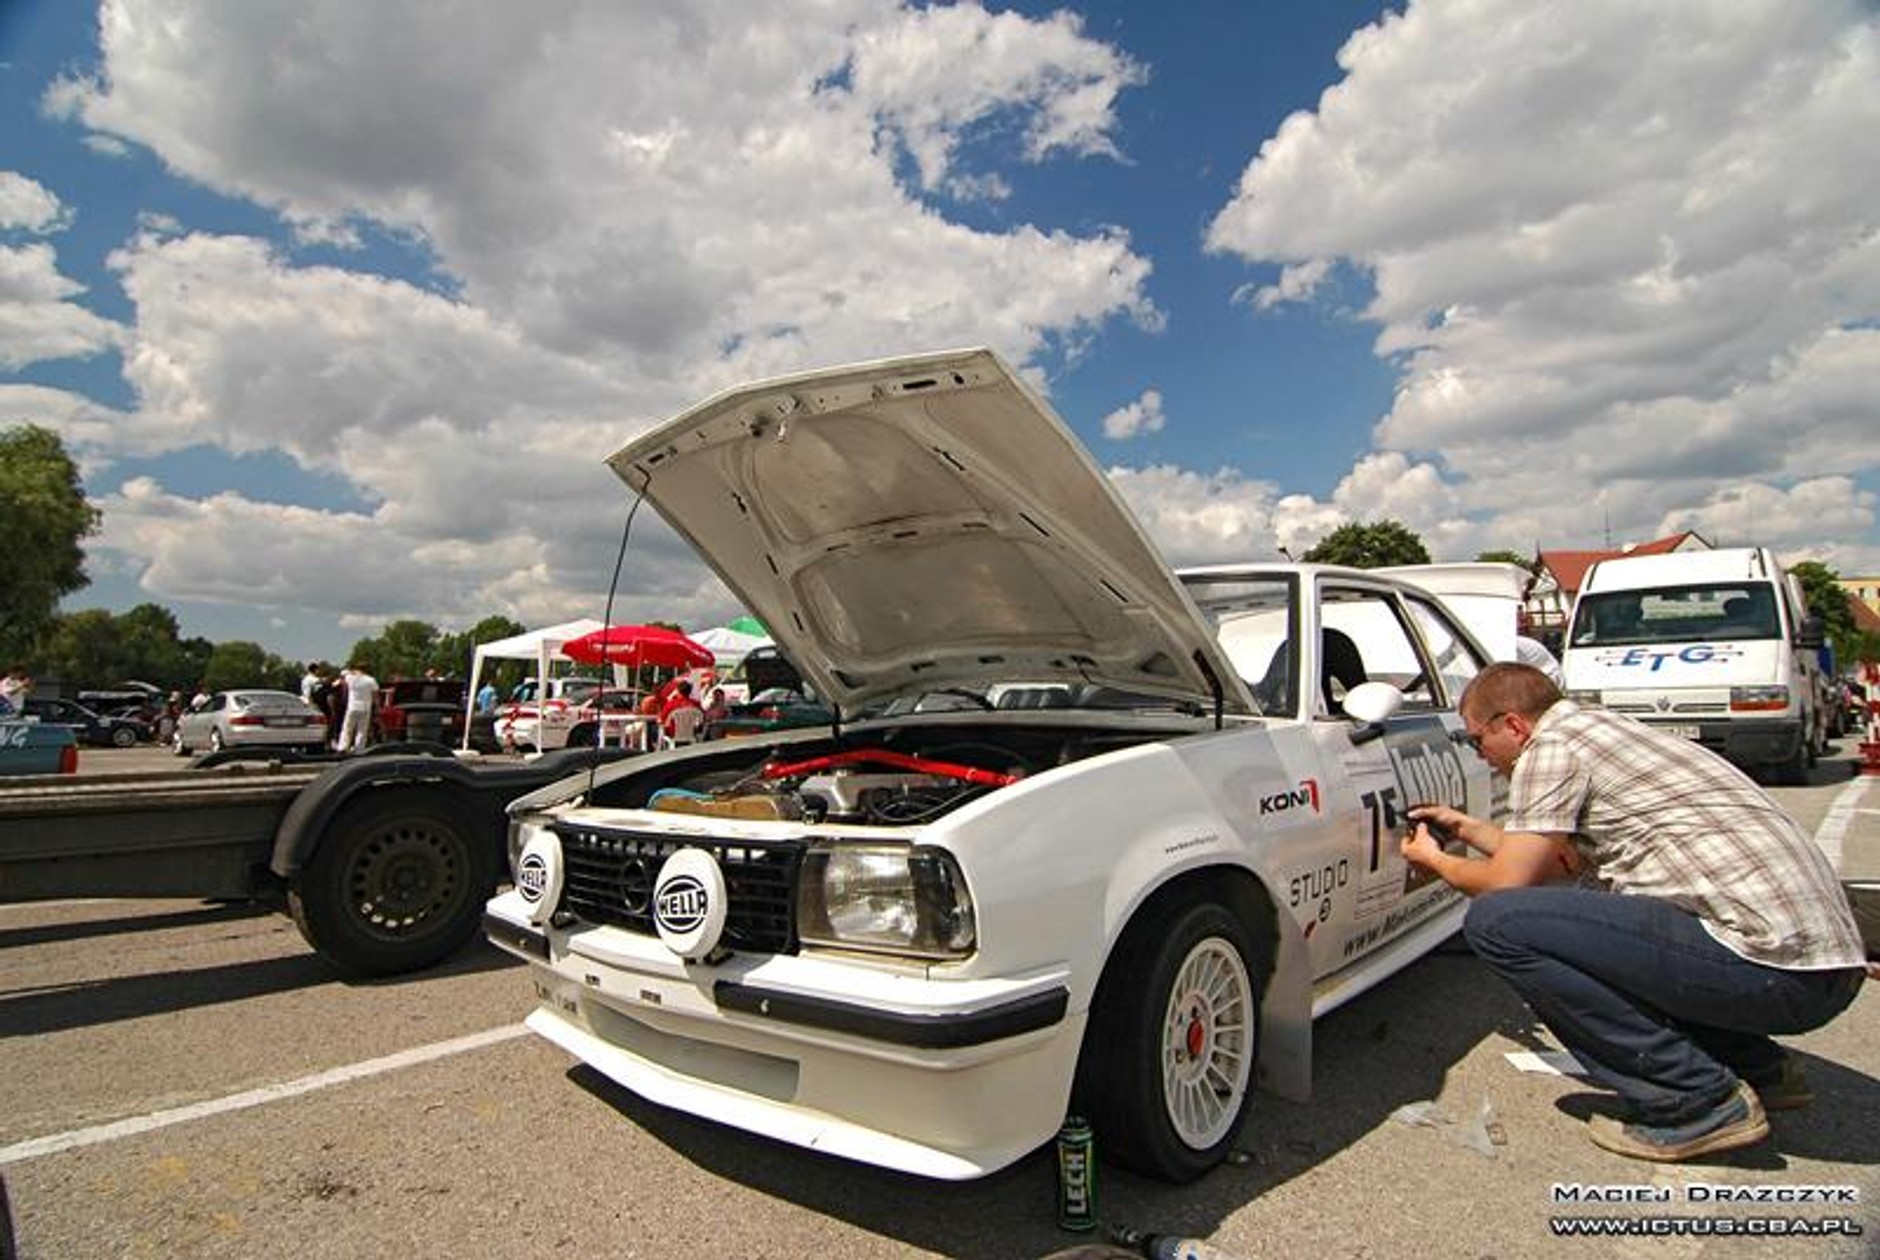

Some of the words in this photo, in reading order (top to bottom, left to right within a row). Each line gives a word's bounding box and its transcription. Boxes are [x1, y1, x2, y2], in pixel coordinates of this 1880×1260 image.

[1620, 645, 1715, 671] ETG
[1260, 788, 1310, 815] KONI
[520, 869, 546, 888] HELLA
[1290, 859, 1348, 907] STUDIO
[657, 891, 708, 916] HELLA
[1067, 1153, 1087, 1214] LECH
